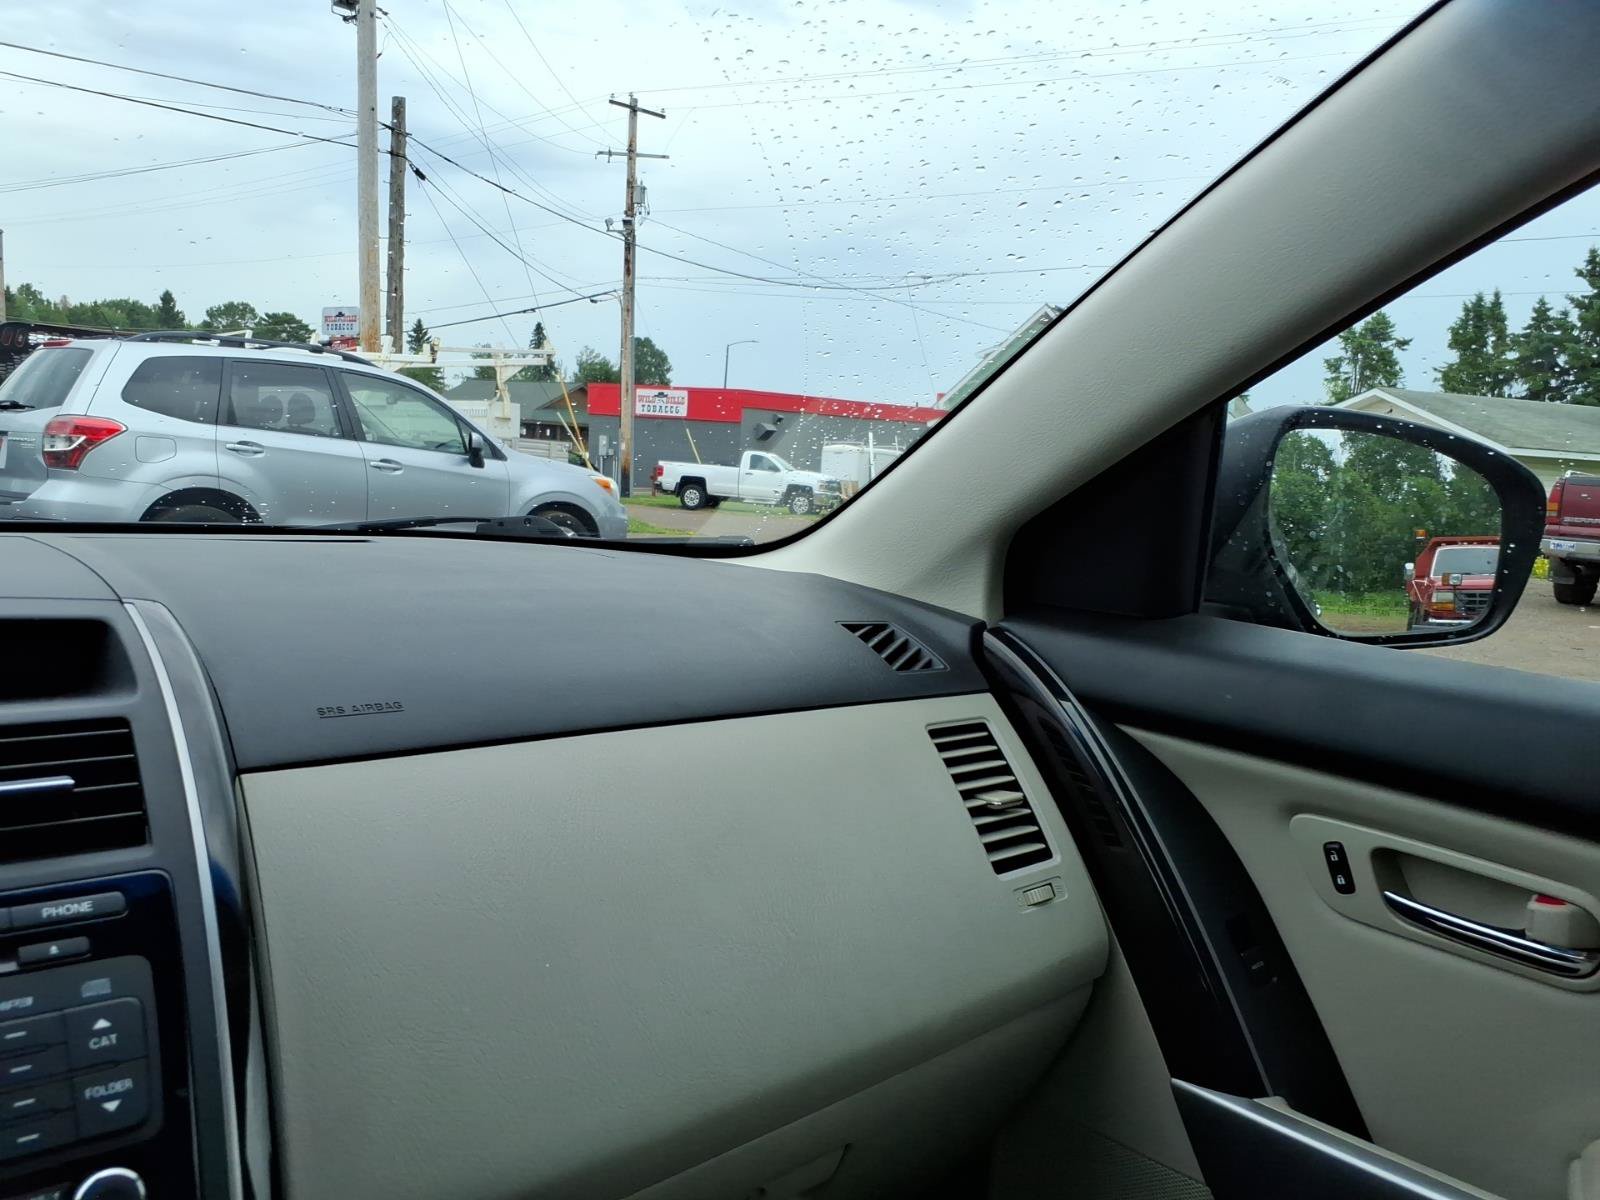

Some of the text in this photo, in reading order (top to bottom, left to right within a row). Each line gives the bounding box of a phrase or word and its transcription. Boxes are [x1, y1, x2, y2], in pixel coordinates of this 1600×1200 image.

[641, 404, 680, 414] TOBACCO
[316, 701, 404, 716] SRS AIRBAG
[41, 900, 95, 919] PHONE
[88, 1033, 117, 1050] CAT
[84, 1078, 133, 1099] FOLDER
